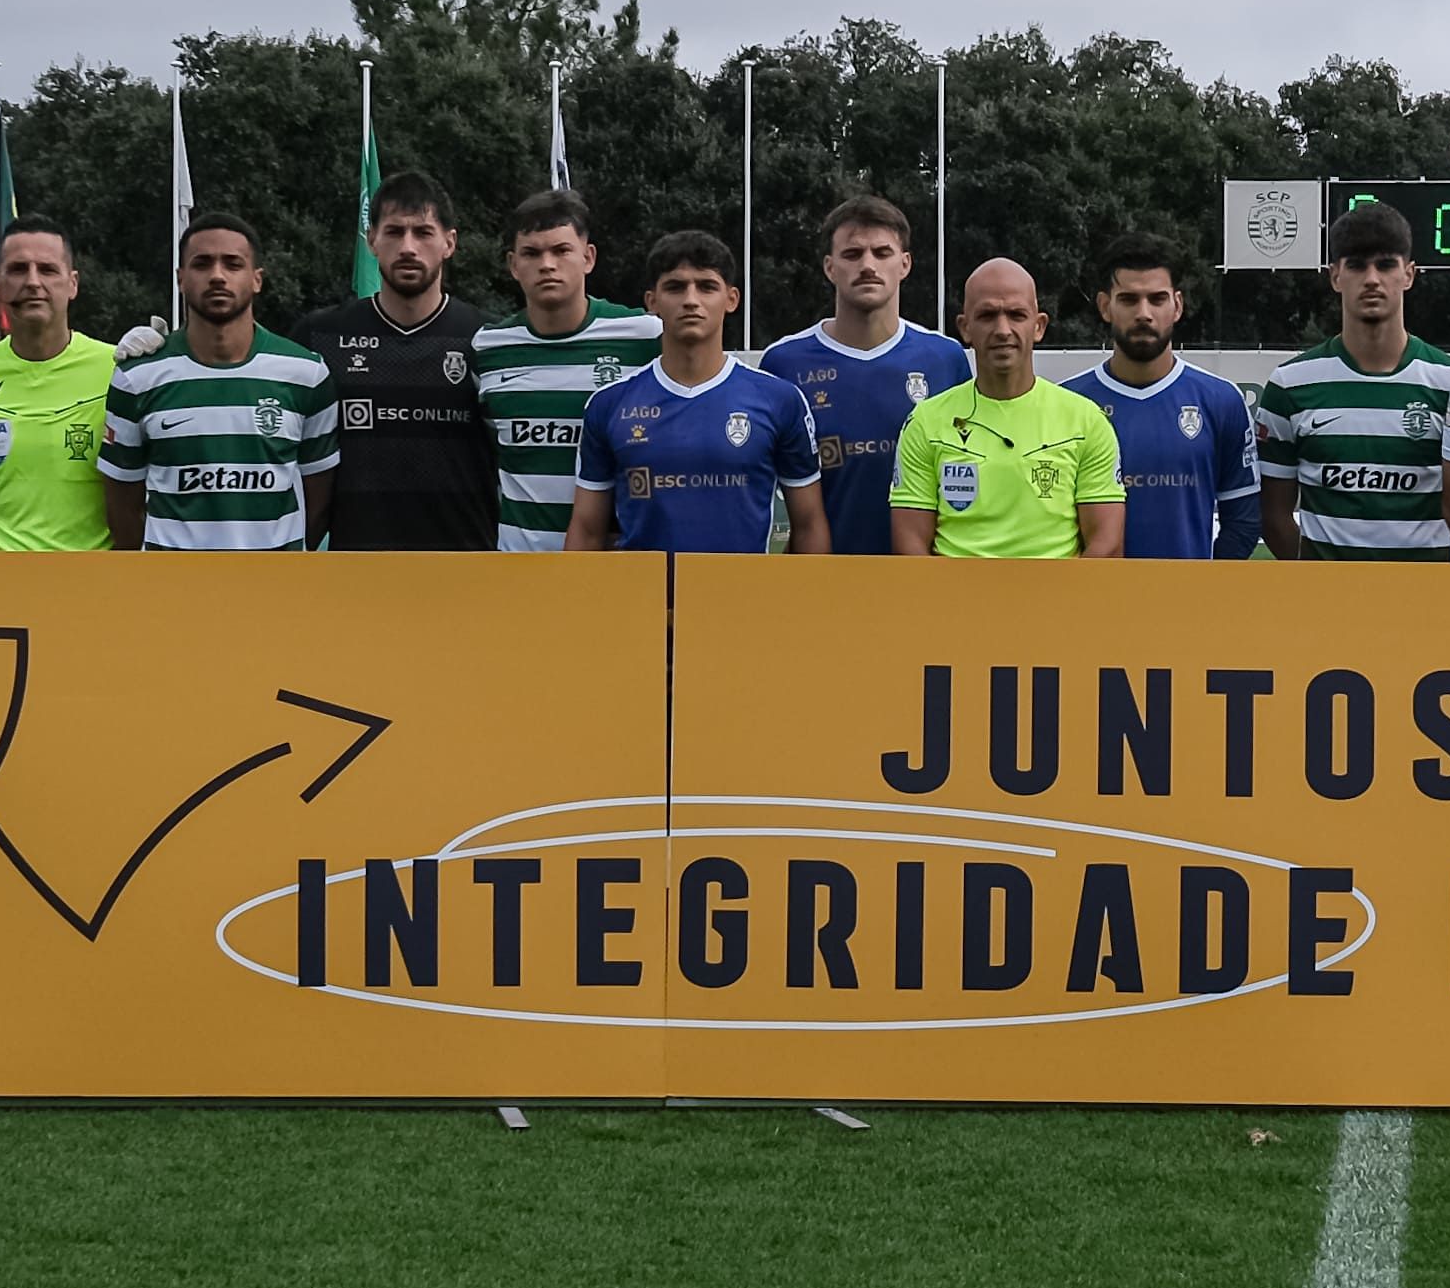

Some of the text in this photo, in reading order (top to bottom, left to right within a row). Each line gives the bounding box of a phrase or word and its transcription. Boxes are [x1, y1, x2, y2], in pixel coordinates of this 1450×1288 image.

[1255, 191, 1291, 204] SCP
[339, 335, 379, 349] LAGO
[797, 368, 838, 385] LAGO
[377, 408, 471, 423] ESC ONLINE
[621, 406, 661, 420] LAGO
[511, 419, 582, 444] Beta
[944, 465, 975, 478] FIFA
[1321, 465, 1418, 491] Betano
[177, 466, 275, 492] Betano
[654, 474, 749, 488] ESC ONLINE
[1123, 473, 1199, 487] SC ONLIN
[296, 856, 1355, 997] INTEGRIDADE
